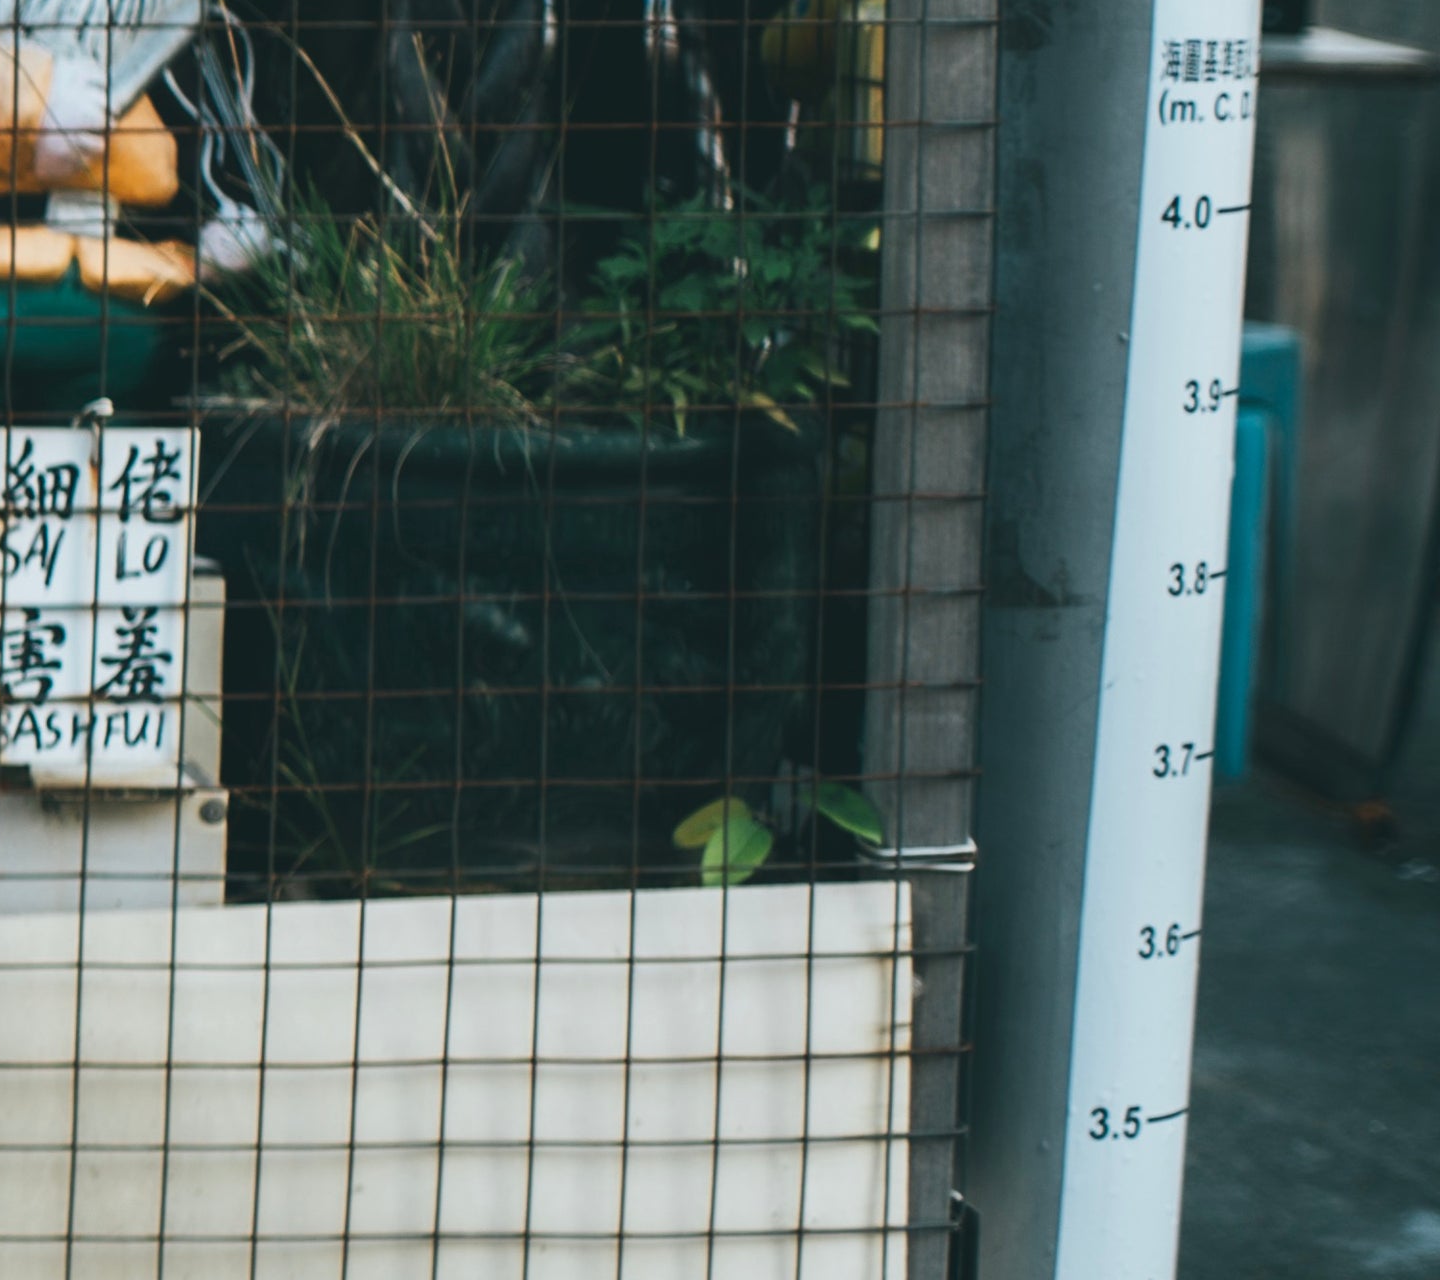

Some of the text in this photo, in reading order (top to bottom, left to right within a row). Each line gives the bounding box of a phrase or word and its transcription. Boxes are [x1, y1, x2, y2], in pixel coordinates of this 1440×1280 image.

[1161, 195, 1211, 230] 4.0
[1183, 379, 1222, 414] 3.9
[116, 530, 168, 581] LO
[1167, 561, 1208, 598] 3.8
[1152, 742, 1195, 779] 3.7
[1138, 923, 1180, 960] 3.6
[1088, 1105, 1142, 1142] 3.5
